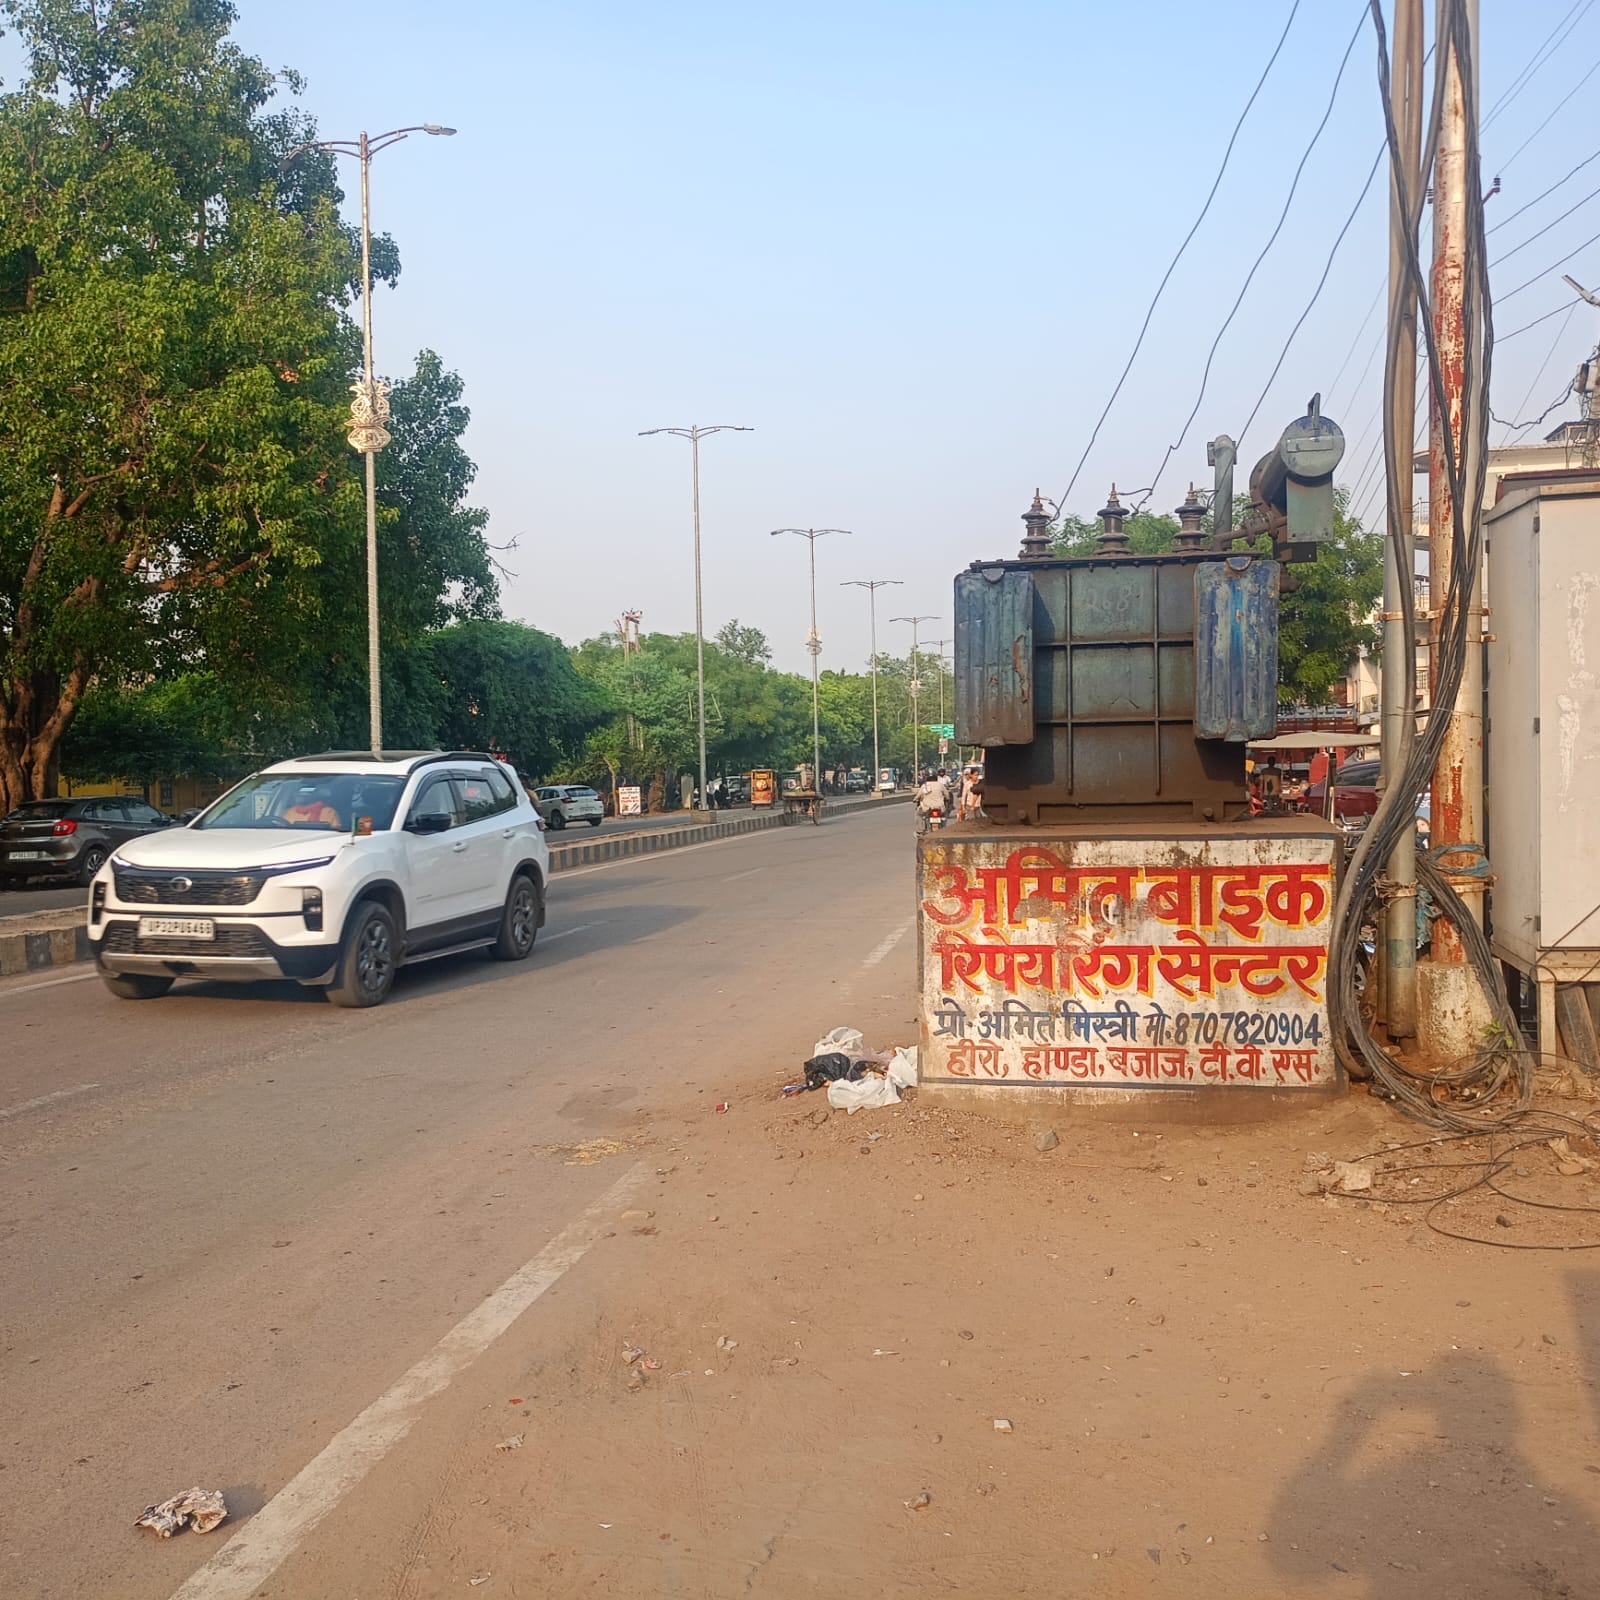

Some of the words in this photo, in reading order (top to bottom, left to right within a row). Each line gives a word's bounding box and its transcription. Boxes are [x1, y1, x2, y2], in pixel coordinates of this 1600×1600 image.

[922, 846, 1142, 931] अमित
[1144, 863, 1334, 942] बाइक
[1158, 929, 1328, 1002] सेन्टर
[977, 999, 1056, 1042] अमित
[1060, 999, 1140, 1043] मिस्त्री
[1174, 1011, 1323, 1046] 8707820904
[946, 1038, 1009, 1079] हीरो,
[1106, 1046, 1194, 1081] बजाज,
